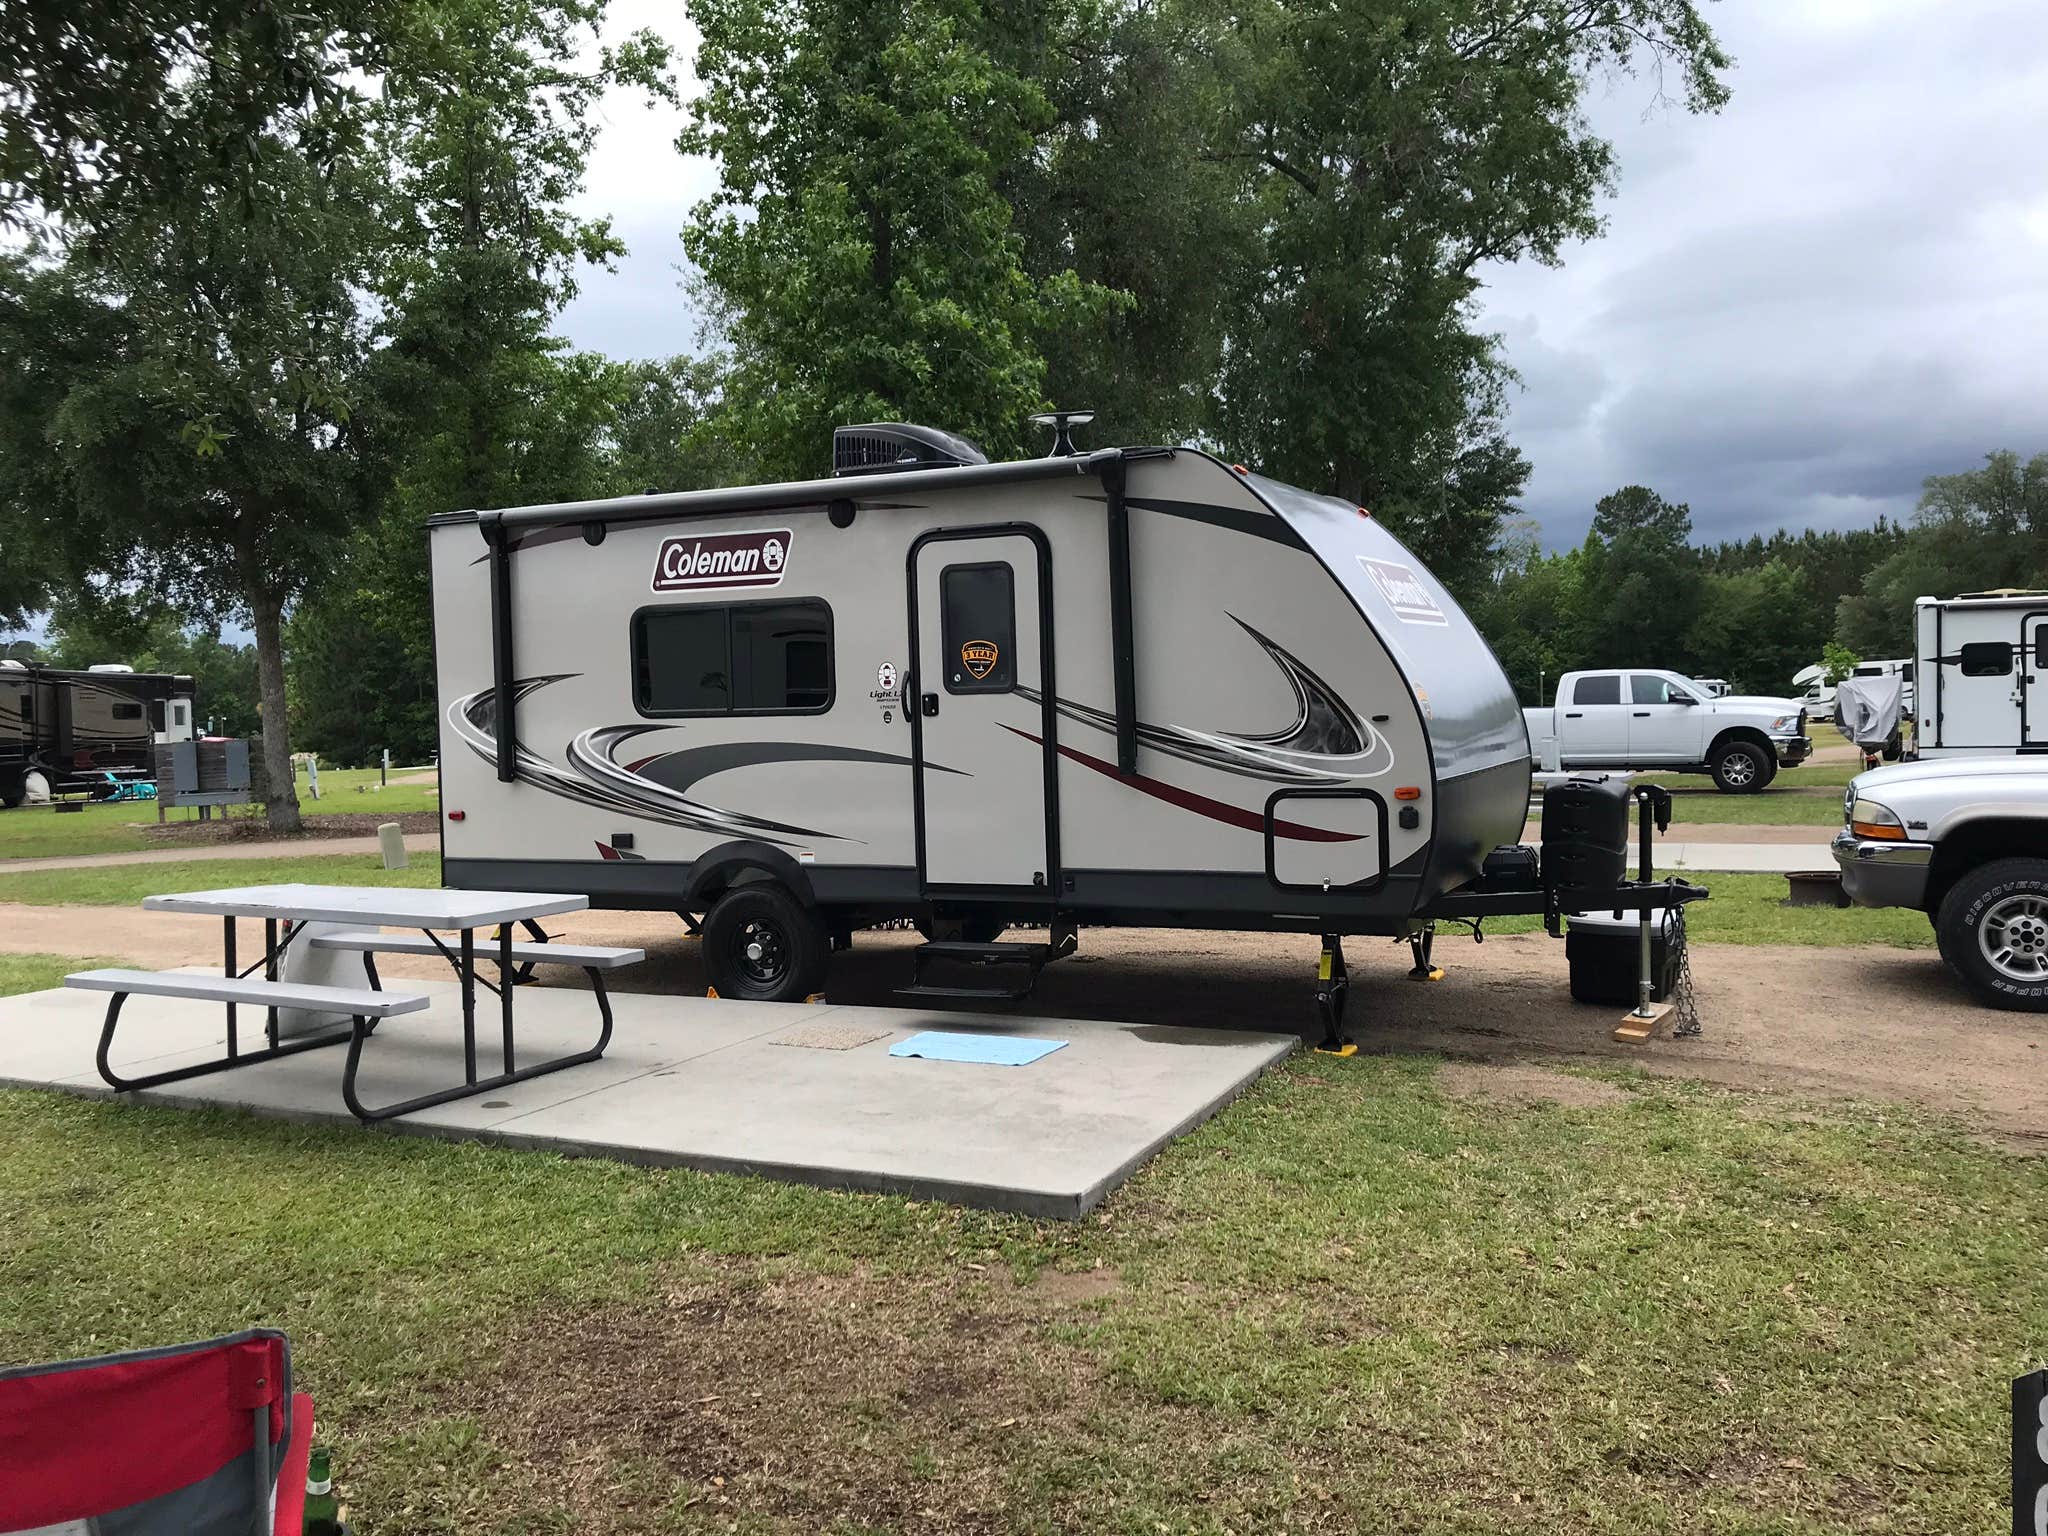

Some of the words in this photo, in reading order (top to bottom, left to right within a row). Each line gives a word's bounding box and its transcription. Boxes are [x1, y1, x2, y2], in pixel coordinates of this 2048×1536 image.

[663, 542, 760, 579] Coleman
[972, 650, 994, 660] YEAR
[869, 690, 892, 699] Light
